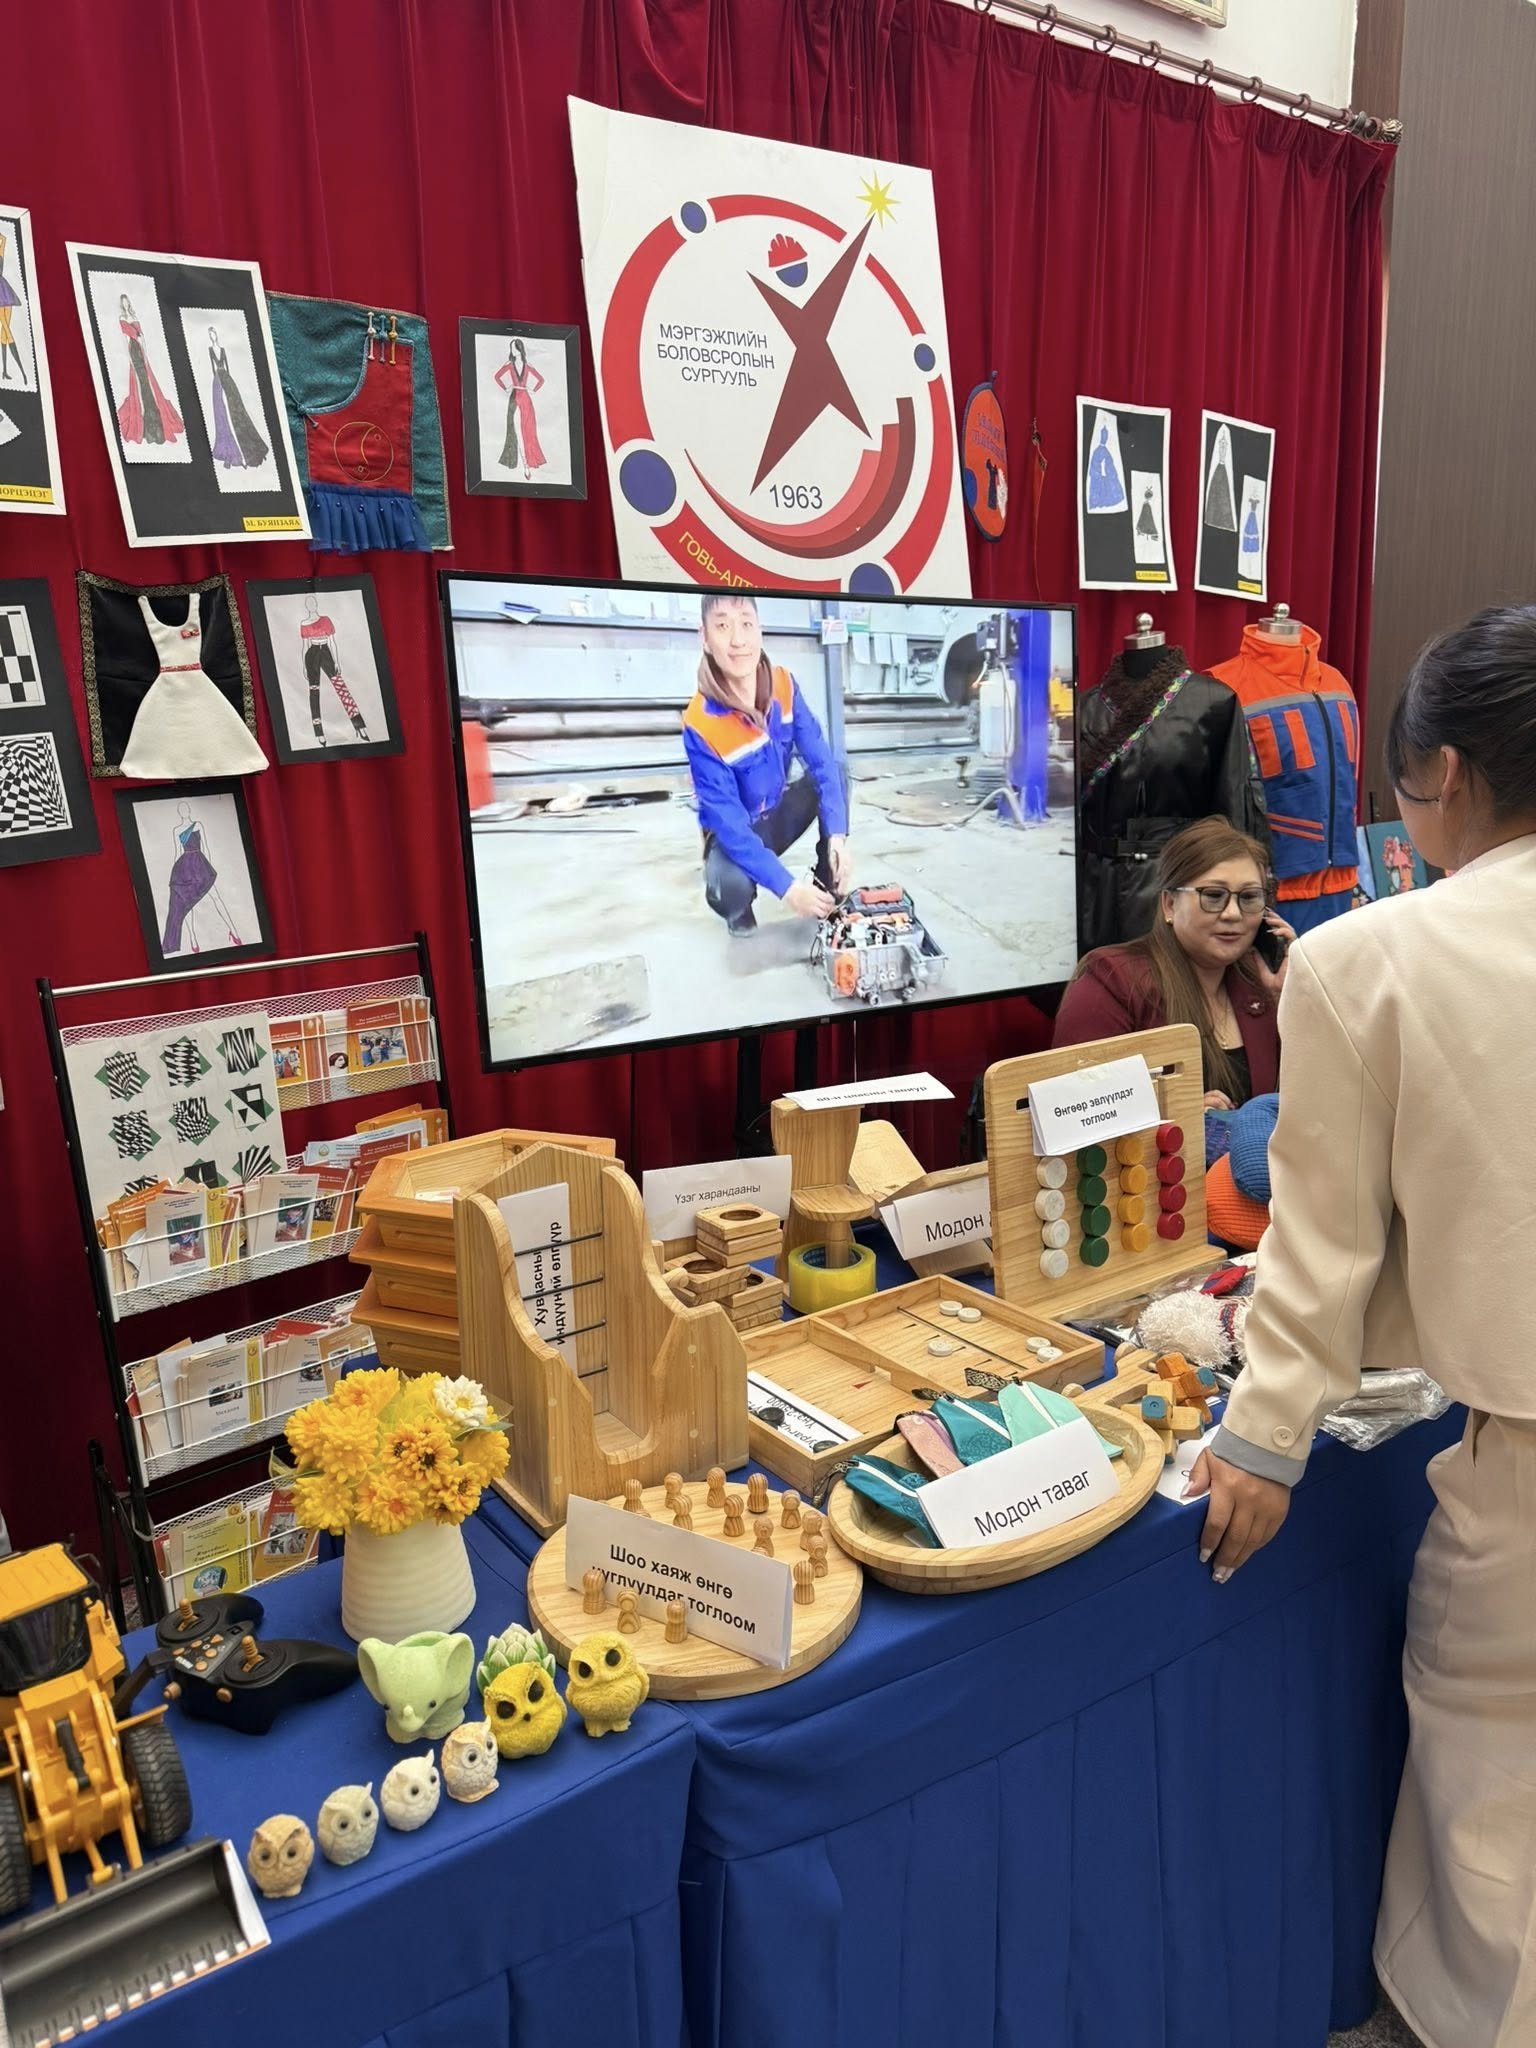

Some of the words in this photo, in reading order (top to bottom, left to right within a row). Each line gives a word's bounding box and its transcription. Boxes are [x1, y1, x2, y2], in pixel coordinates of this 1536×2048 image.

[659, 323, 768, 349] МЭРГЭЖЛИЙН
[657, 343, 775, 369] БОЛОВСРОЛЫН
[681, 366, 758, 387] СУРГУУЛЬ
[0, 486, 48, 498] ОРЦЭЦЭГ
[769, 484, 823, 510] 1963
[678, 531, 767, 589] ГОВЬ-АЛТ
[1054, 1101, 1088, 1118] Өнгөөр
[1089, 1088, 1134, 1108] эвлүүлдэг
[1080, 1109, 1118, 1127] тоглоом
[674, 1193, 696, 1204] Үзэг
[698, 1184, 761, 1202] харандааны
[925, 1213, 985, 1242] Модон
[973, 1495, 1042, 1537] Модон
[1041, 1470, 1090, 1505] таваг
[609, 1544, 647, 1569] Шоо
[650, 1560, 692, 1584] хаяж
[696, 1576, 734, 1600] өнгө
[592, 1565, 684, 1603] углуулда
[687, 1597, 756, 1635] тоглоом
